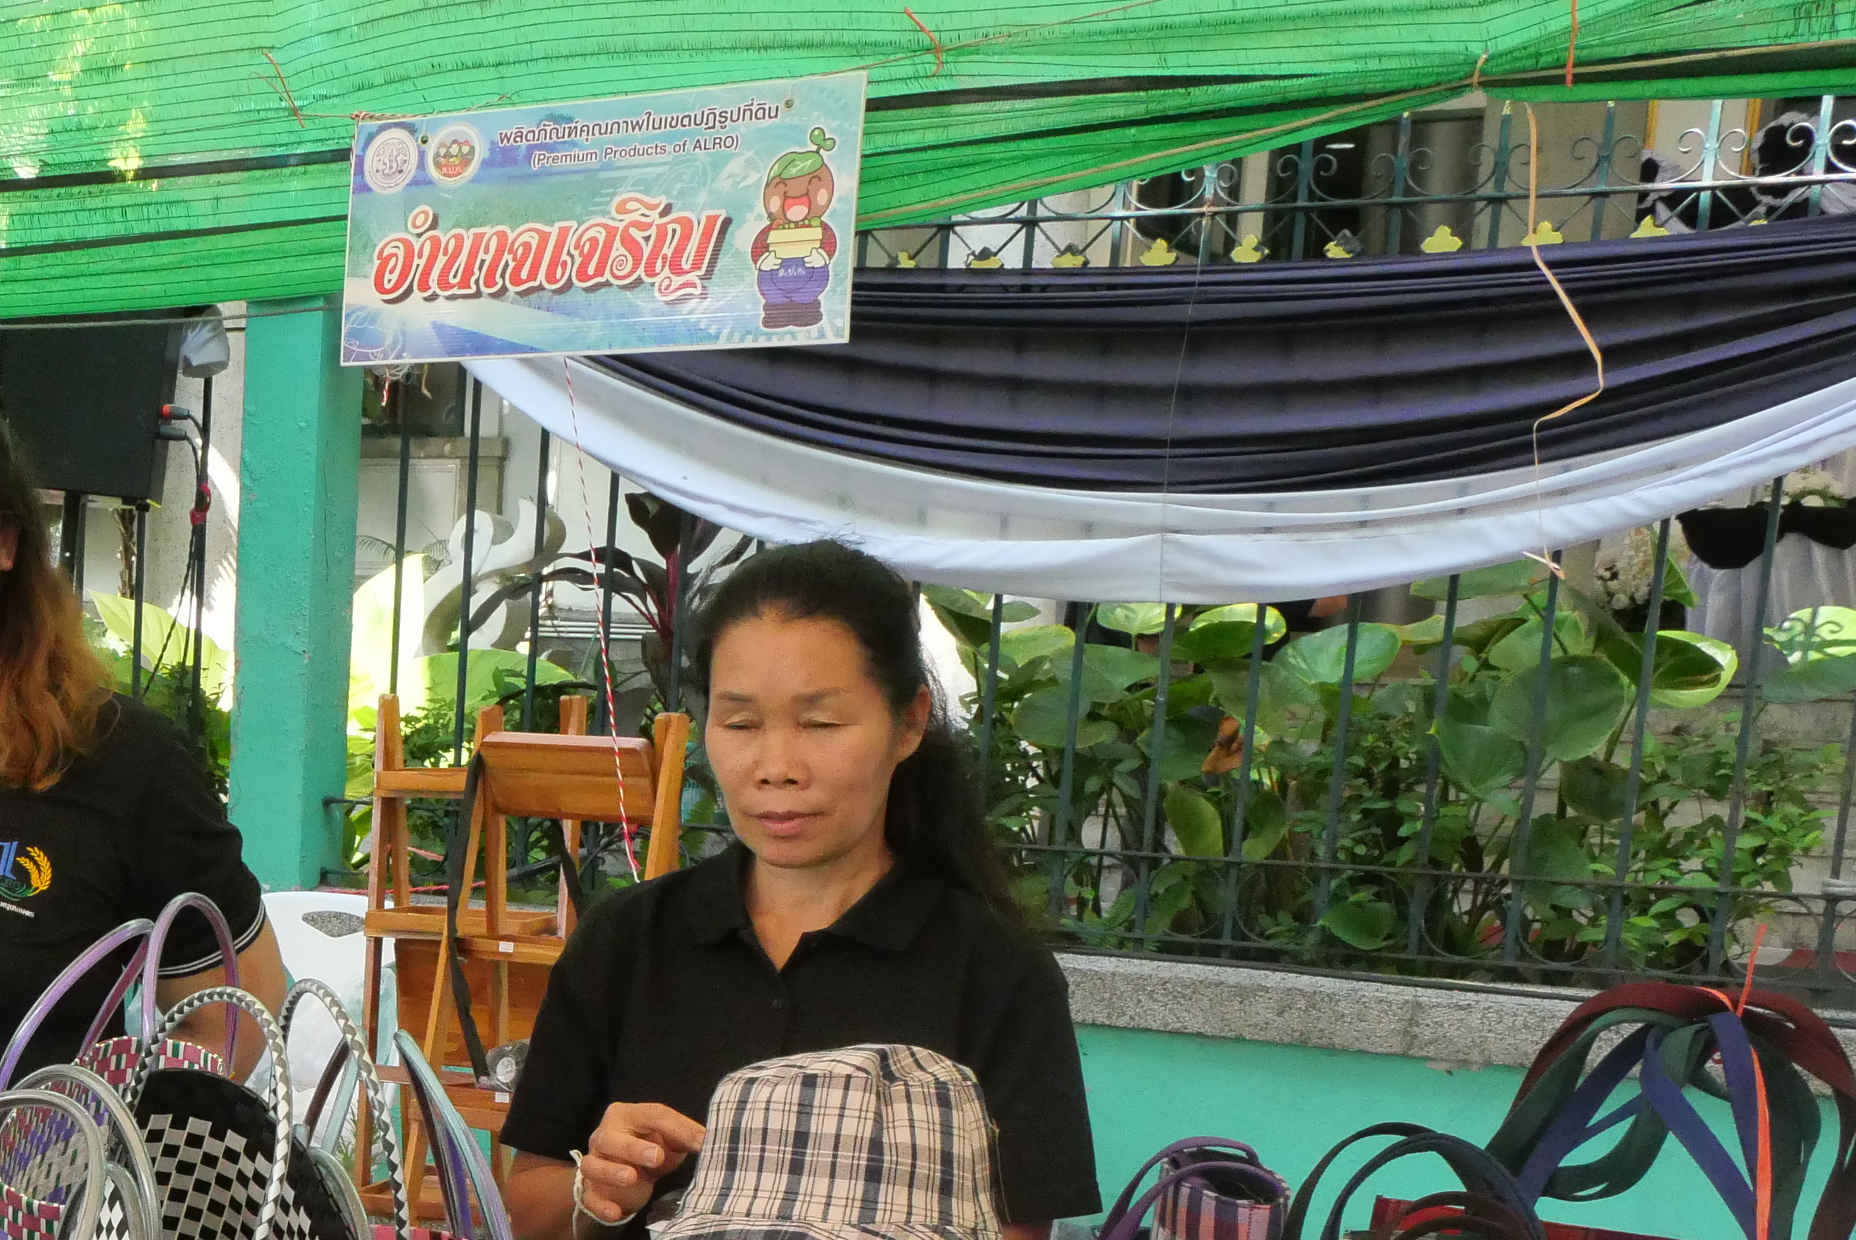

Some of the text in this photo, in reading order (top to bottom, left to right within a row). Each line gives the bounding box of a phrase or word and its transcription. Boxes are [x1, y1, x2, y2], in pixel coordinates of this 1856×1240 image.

[499, 98, 780, 146] ผลิตภัณฑ์คุณภาพในเขตปฏิรูปที่ดิน
[532, 135, 740, 169] (Premium Products of ALRO)
[372, 193, 727, 301] อำนาจเจริญ
